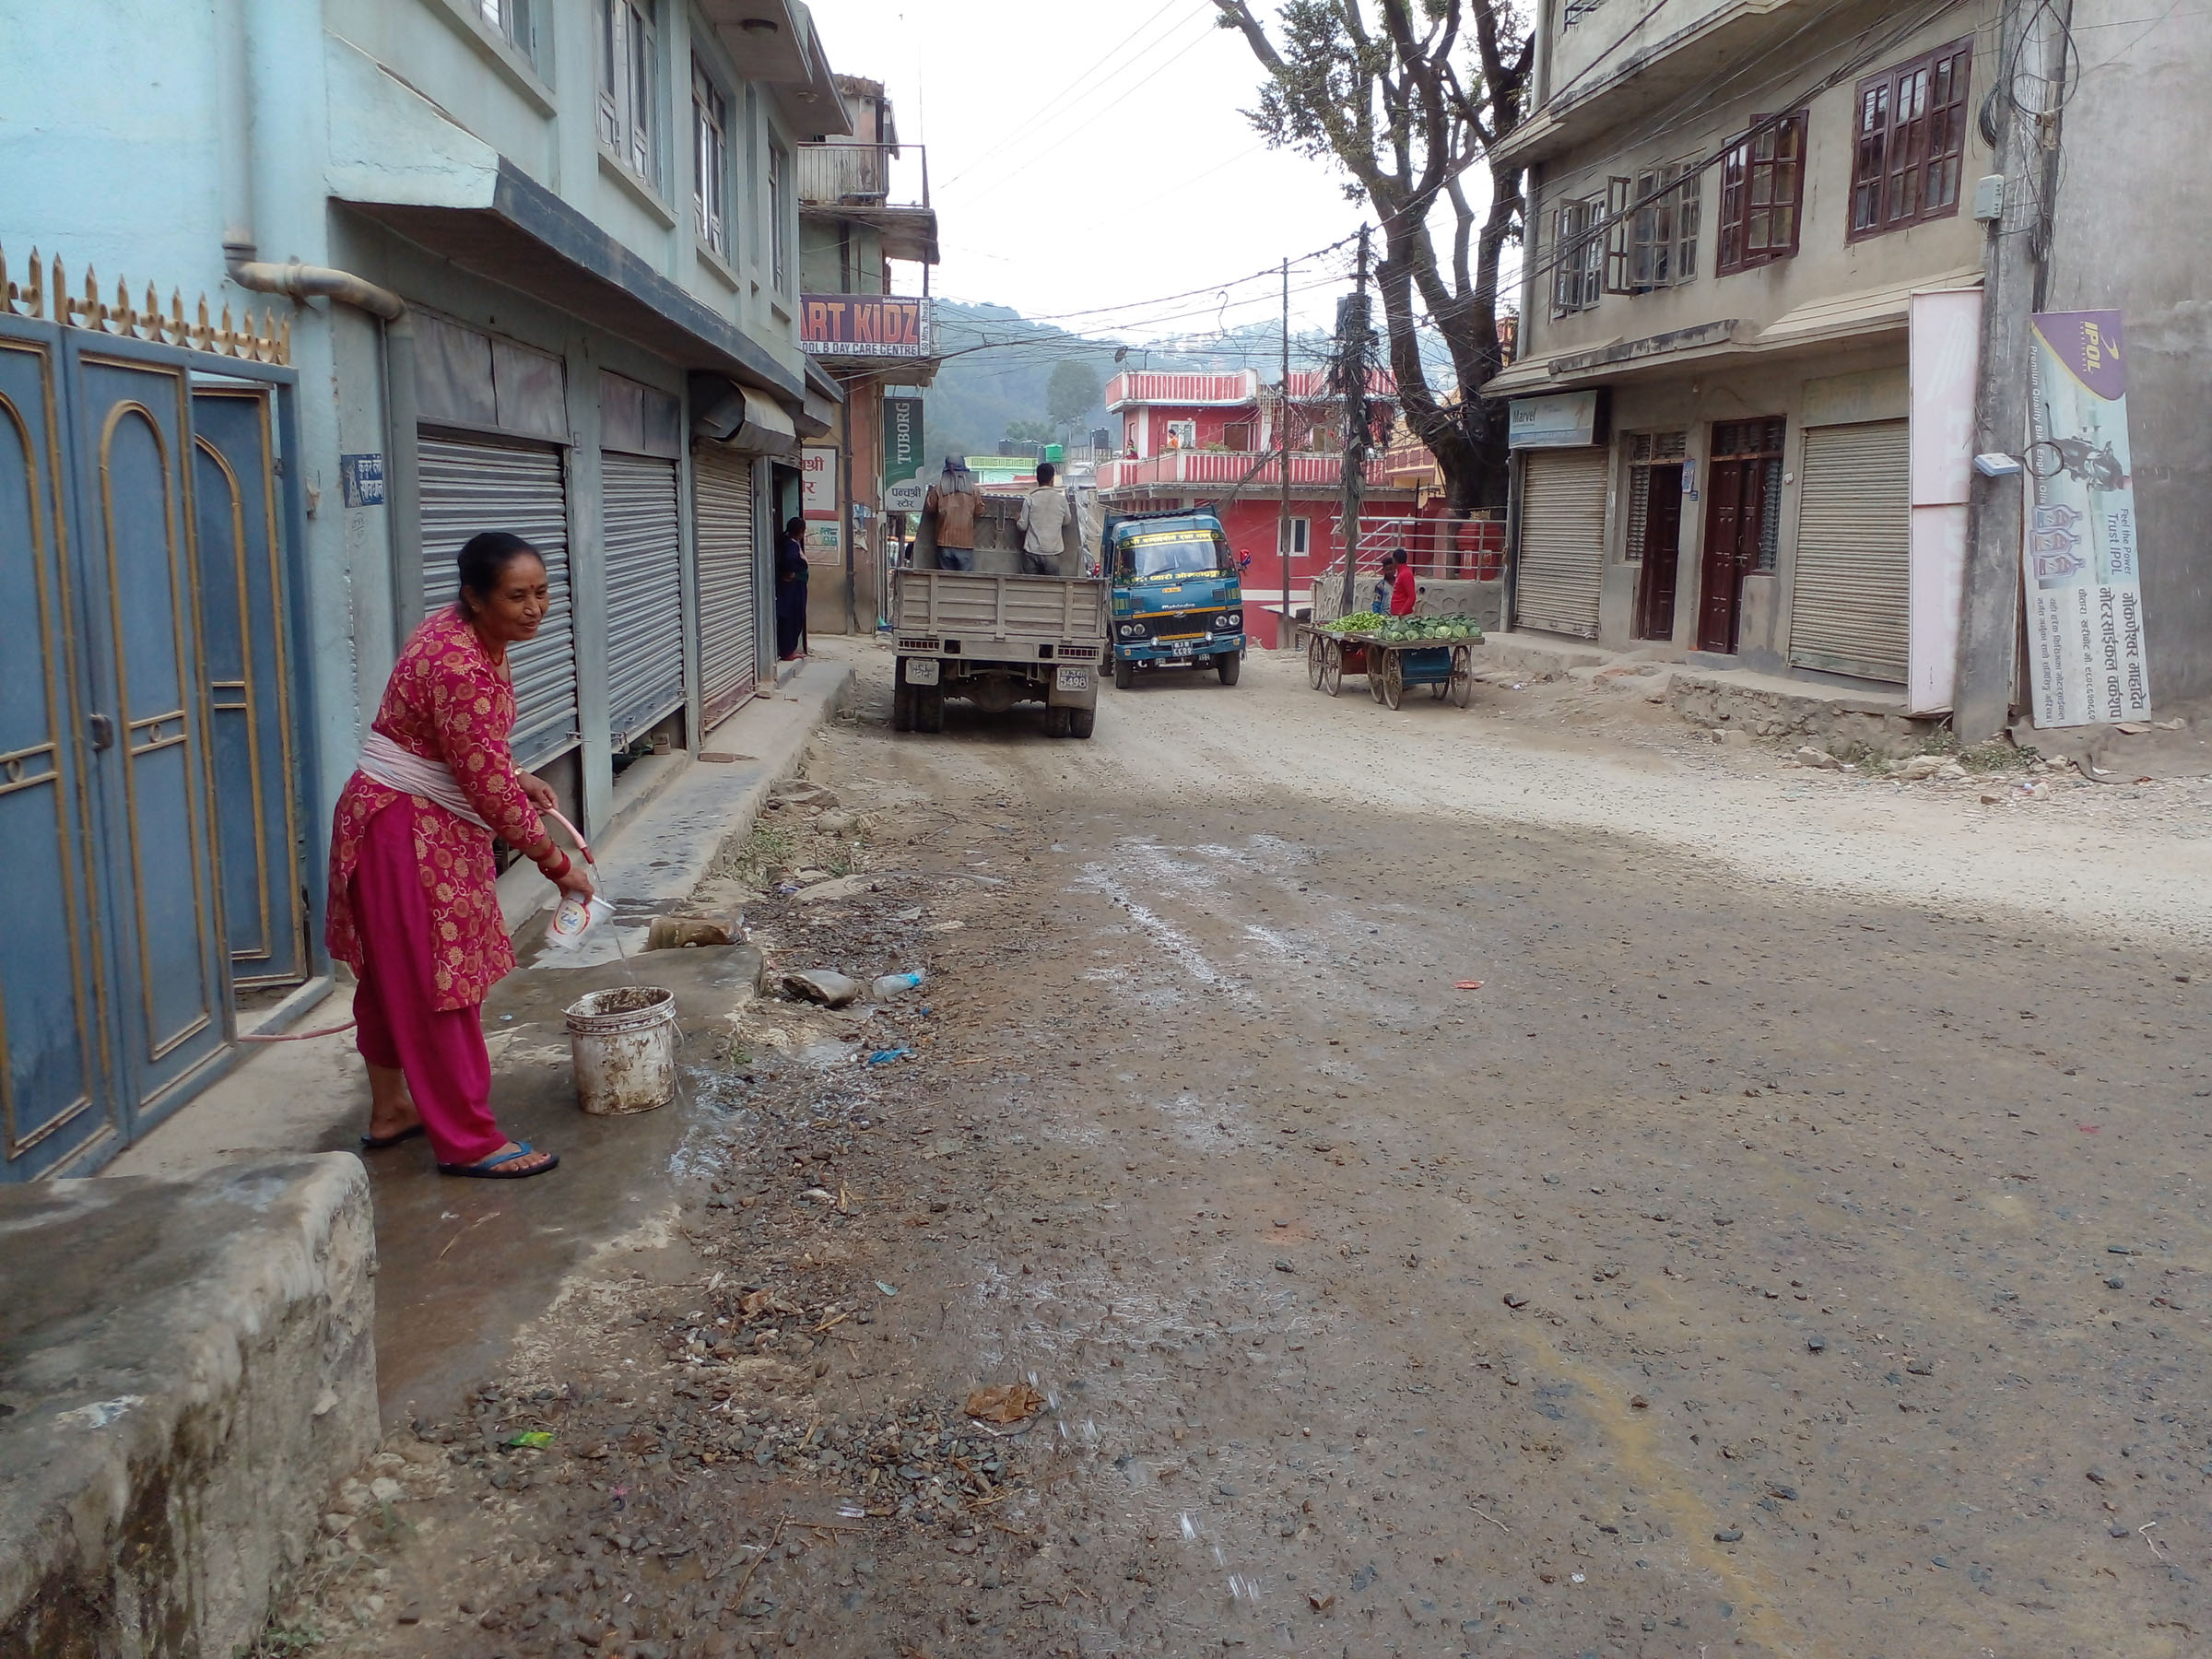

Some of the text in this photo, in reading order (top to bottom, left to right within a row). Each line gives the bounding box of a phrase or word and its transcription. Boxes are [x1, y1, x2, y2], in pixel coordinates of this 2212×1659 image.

[854, 303, 918, 344] KIDZ
[921, 302, 929, 323] Ahead
[823, 343, 830, 353] &
[833, 343, 850, 353] DAY
[853, 344, 877, 355] CARE
[880, 345, 917, 356] CENTRE
[2085, 321, 2101, 372] IPOL
[1513, 407, 1536, 423] Marvel
[2032, 388, 2042, 422] Quality
[896, 402, 912, 465] TUBORG
[896, 498, 914, 508] स्टोर
[2108, 512, 2123, 576] Trust IPOL
[2120, 507, 2133, 575] Feel the Power
[2099, 587, 2124, 719] मोटरसाईकल वर्कशप
[1060, 677, 1087, 688] 5498
[2128, 661, 2147, 710] माहादेव
